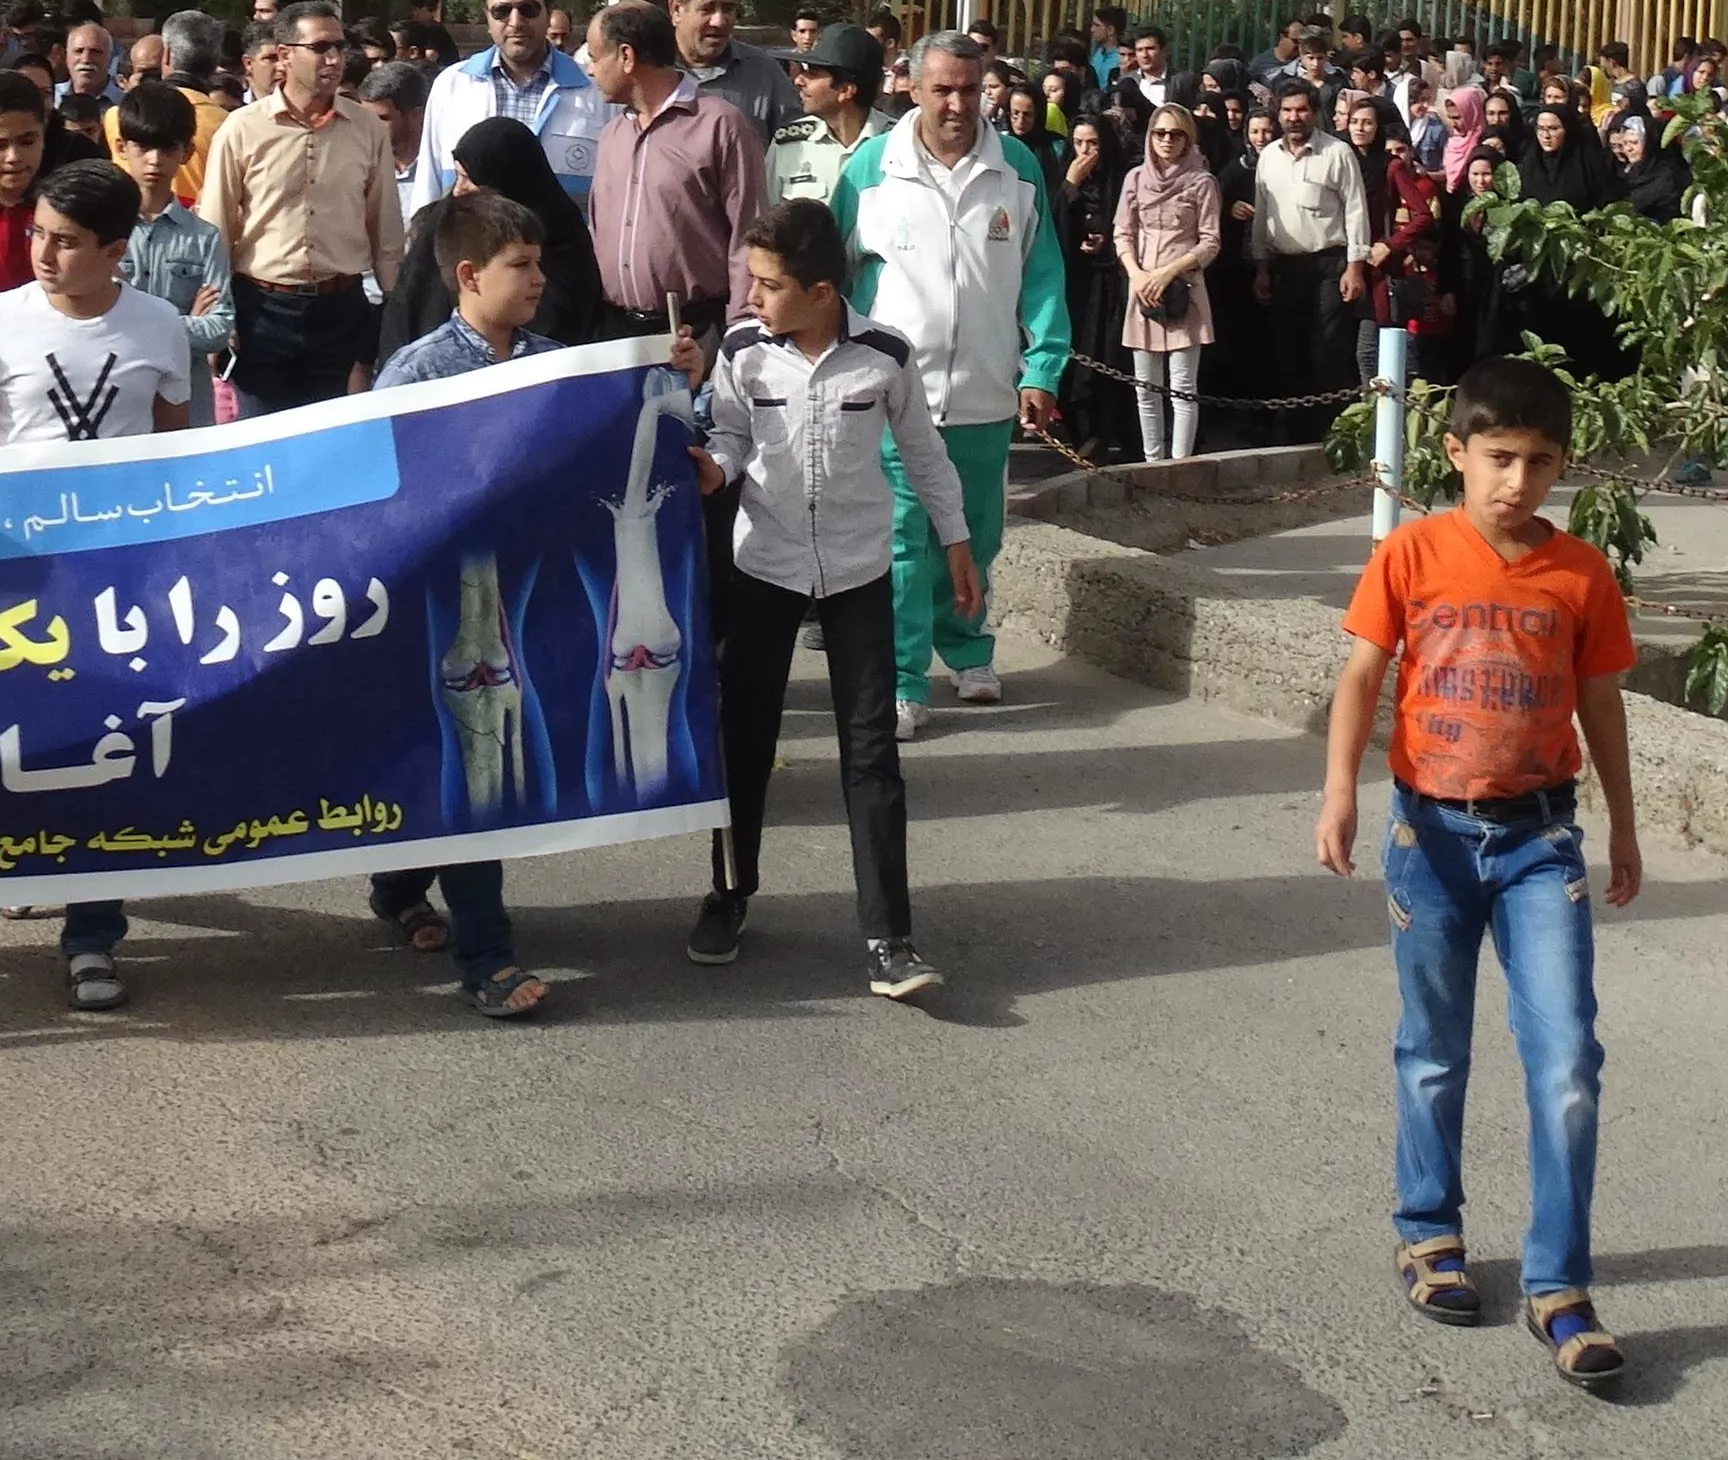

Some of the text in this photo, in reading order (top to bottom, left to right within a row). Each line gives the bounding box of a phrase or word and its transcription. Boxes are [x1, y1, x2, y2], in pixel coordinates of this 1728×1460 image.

[24, 492, 123, 540] سالم
[126, 462, 276, 522] انتخاب
[94, 586, 148, 672] با
[166, 575, 241, 664] را
[263, 571, 388, 652] روز
[88, 819, 195, 852] شبکه
[204, 811, 308, 854] عمومی
[319, 795, 401, 832] روابط
